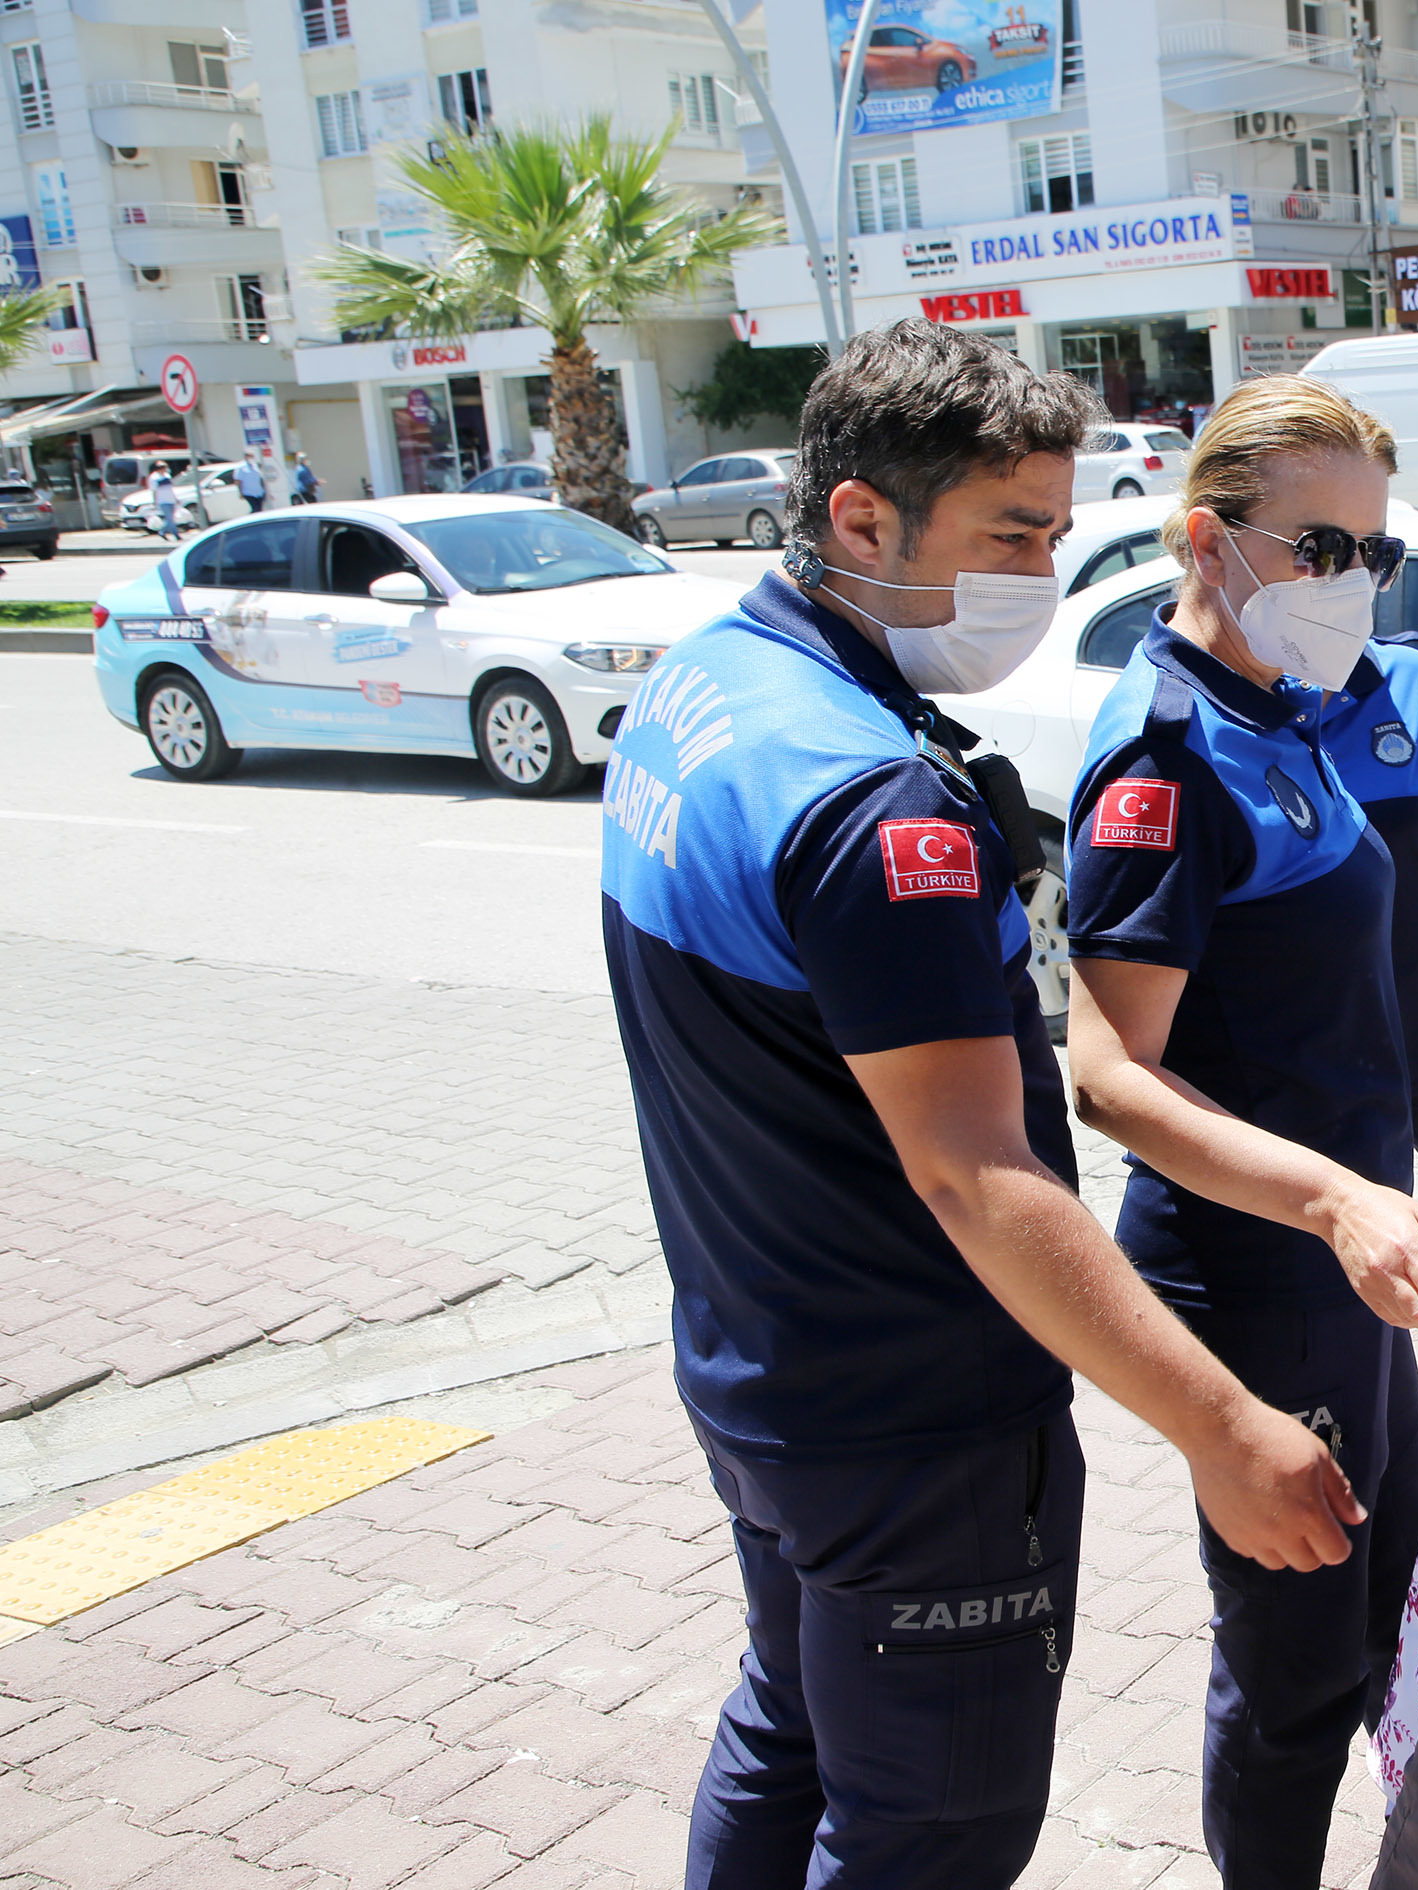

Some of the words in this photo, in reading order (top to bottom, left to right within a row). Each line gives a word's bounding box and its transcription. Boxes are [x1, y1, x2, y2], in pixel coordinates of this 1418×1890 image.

[954, 85, 1006, 110] ethica
[1006, 82, 1051, 104] sigort
[970, 233, 1045, 266] ERDAL
[1053, 225, 1100, 257] SAN
[1245, 268, 1337, 298] VESTEL
[919, 288, 1031, 323] VESTEL
[412, 345, 467, 367] BOSCH
[617, 663, 735, 782] ATAKUM
[603, 749, 683, 870] ZABITA
[1103, 825, 1163, 842] TÜRKİYE
[904, 871, 973, 889] TÜRKİYE
[890, 1586, 1054, 1631] ZABITA
